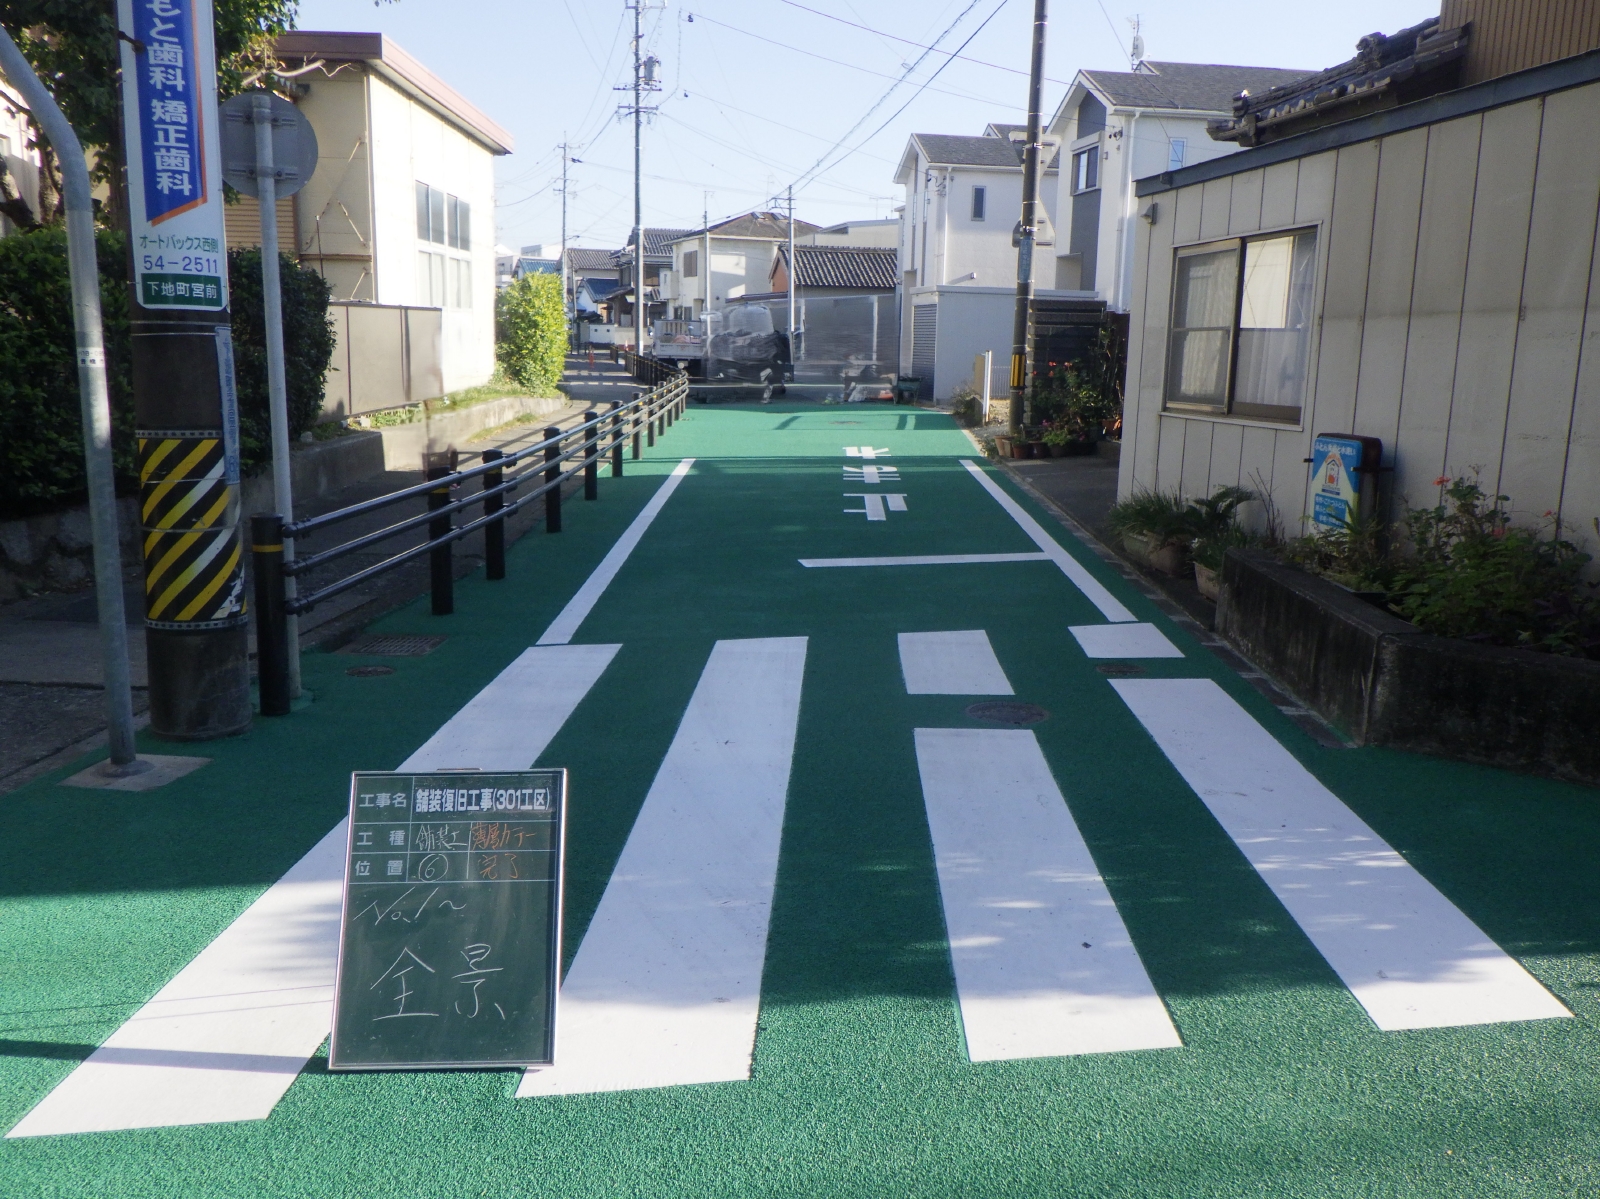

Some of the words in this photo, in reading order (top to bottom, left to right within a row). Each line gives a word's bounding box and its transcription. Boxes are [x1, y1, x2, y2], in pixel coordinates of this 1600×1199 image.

[139, 234, 219, 253] オートバックス西側
[147, 281, 217, 299] 下地町宮前
[359, 792, 407, 808] 工事名
[369, 943, 506, 1021] 全景
